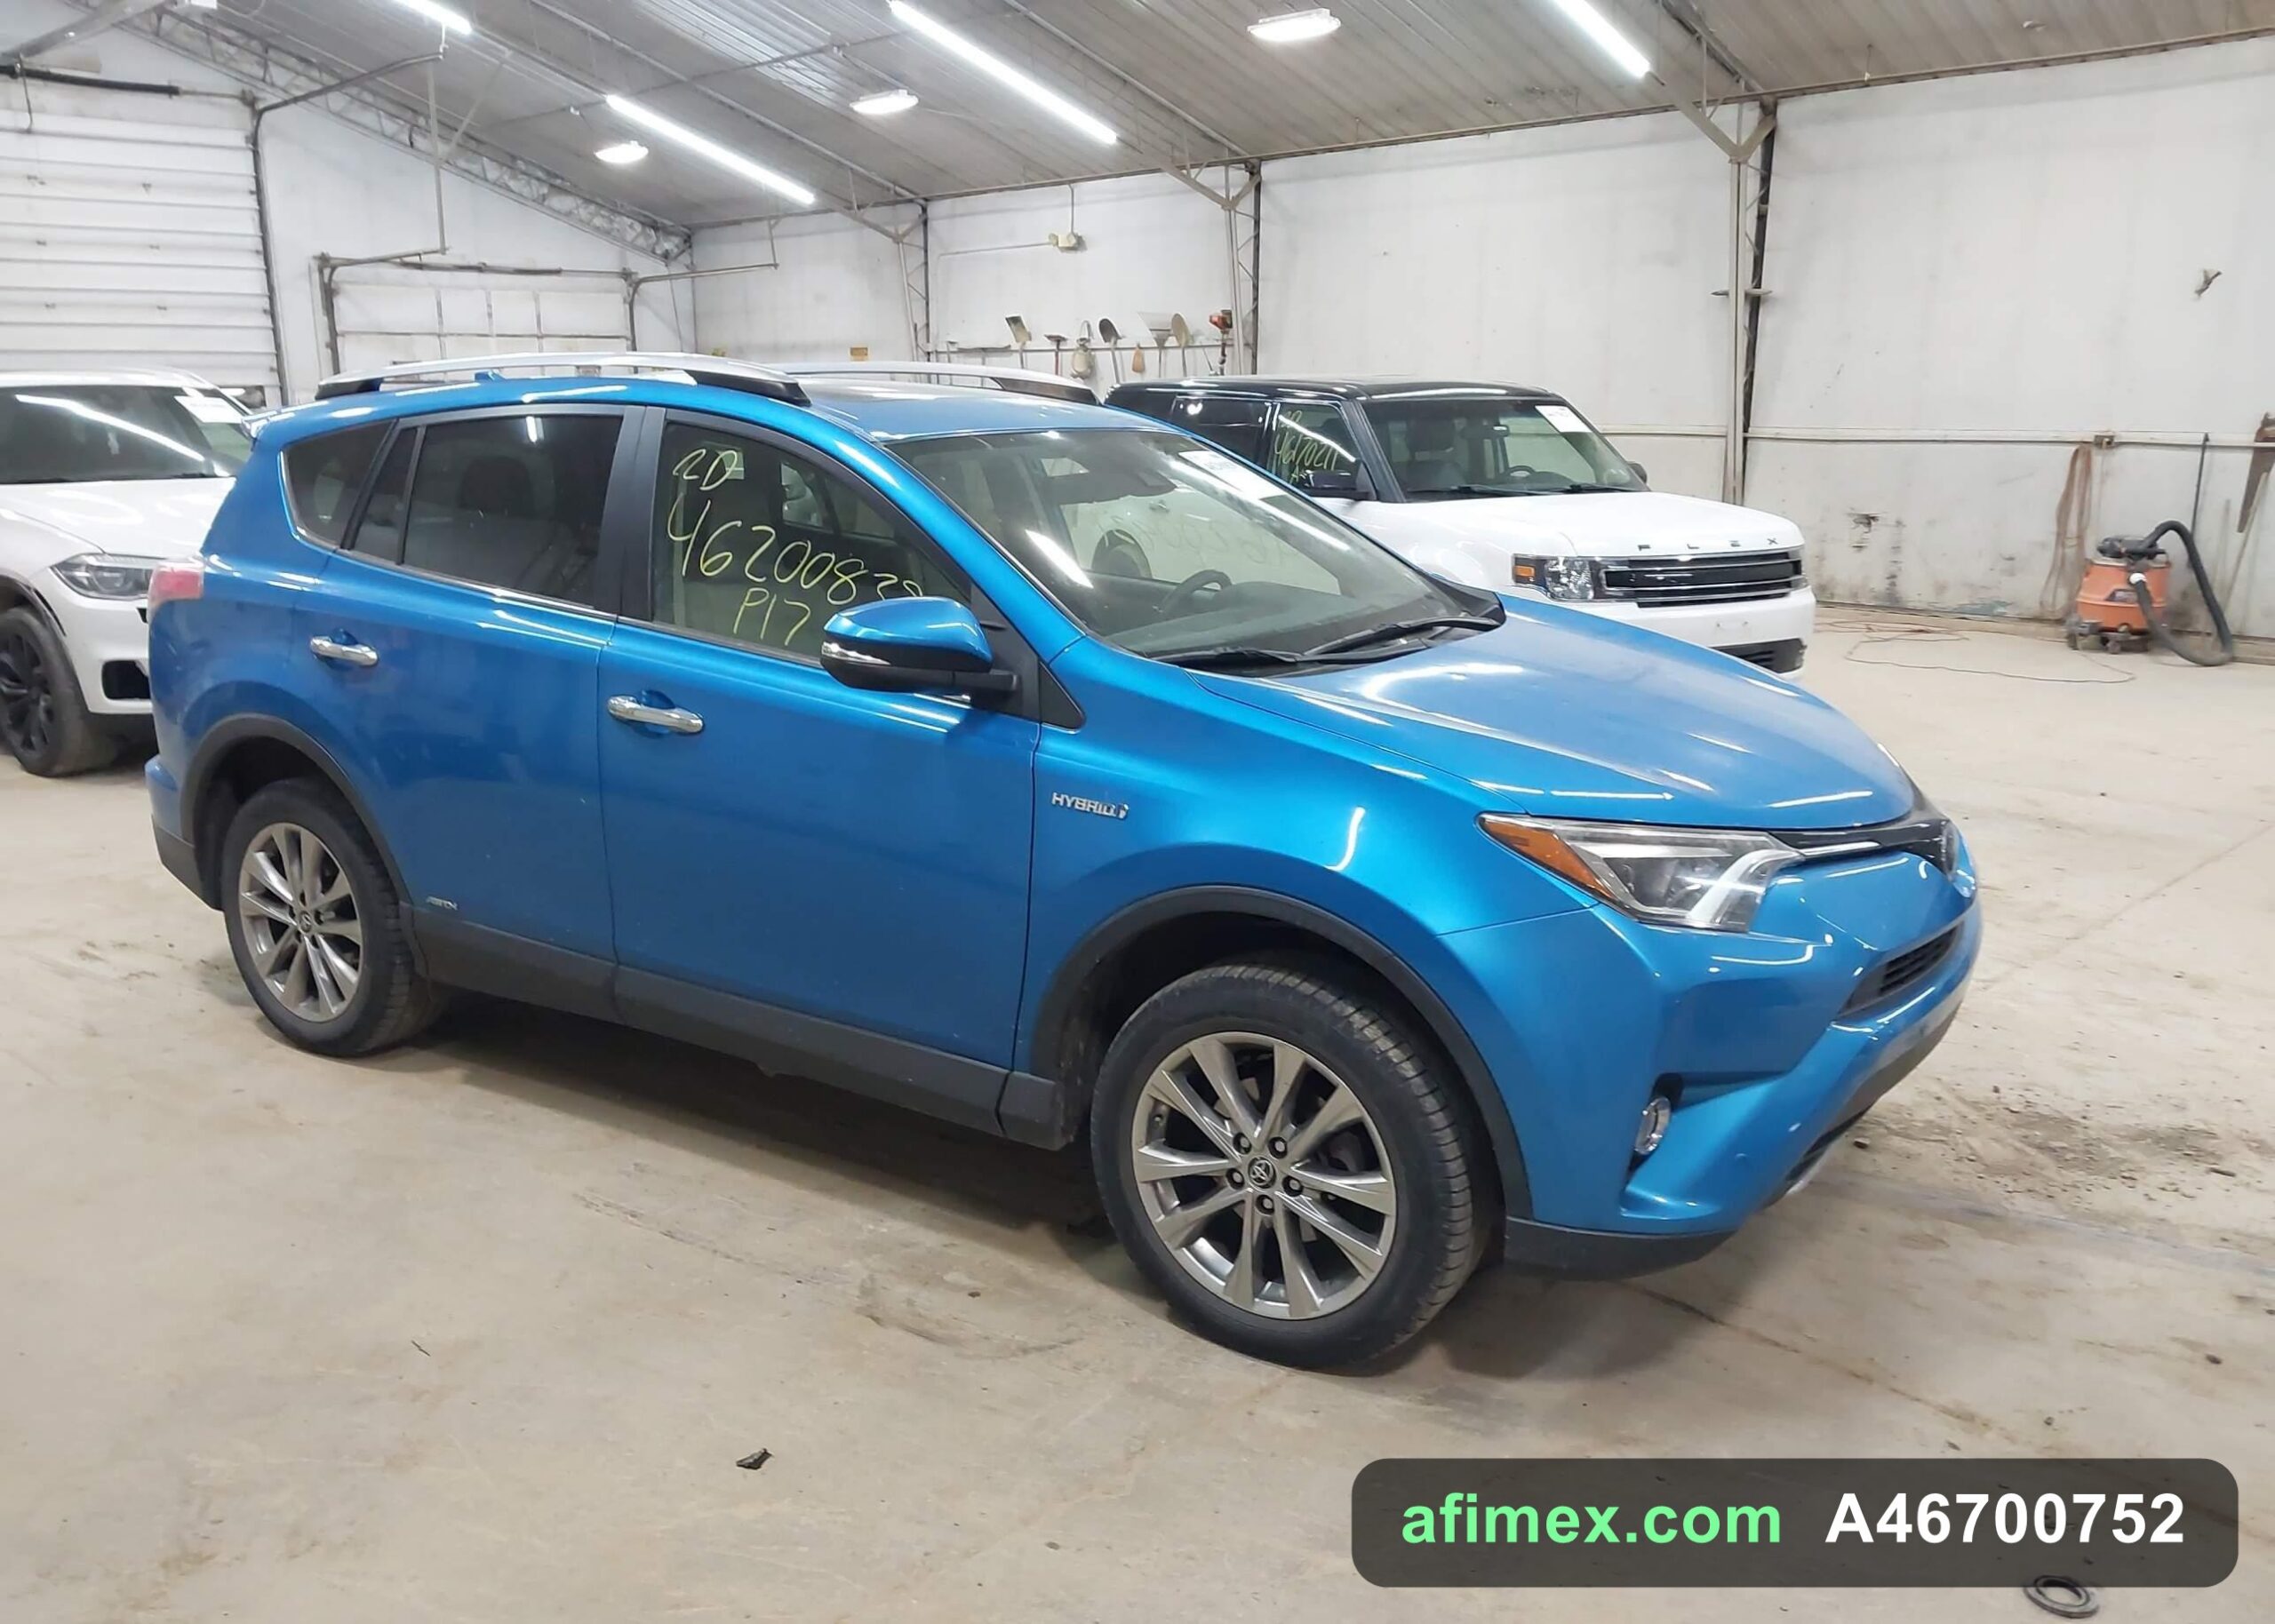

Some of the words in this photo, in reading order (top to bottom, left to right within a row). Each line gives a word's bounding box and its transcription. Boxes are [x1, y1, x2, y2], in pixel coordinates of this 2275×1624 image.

[1638, 537, 1778, 552] FLEX
[733, 587, 810, 646] P17
[1051, 792, 1117, 817] HYBRID
